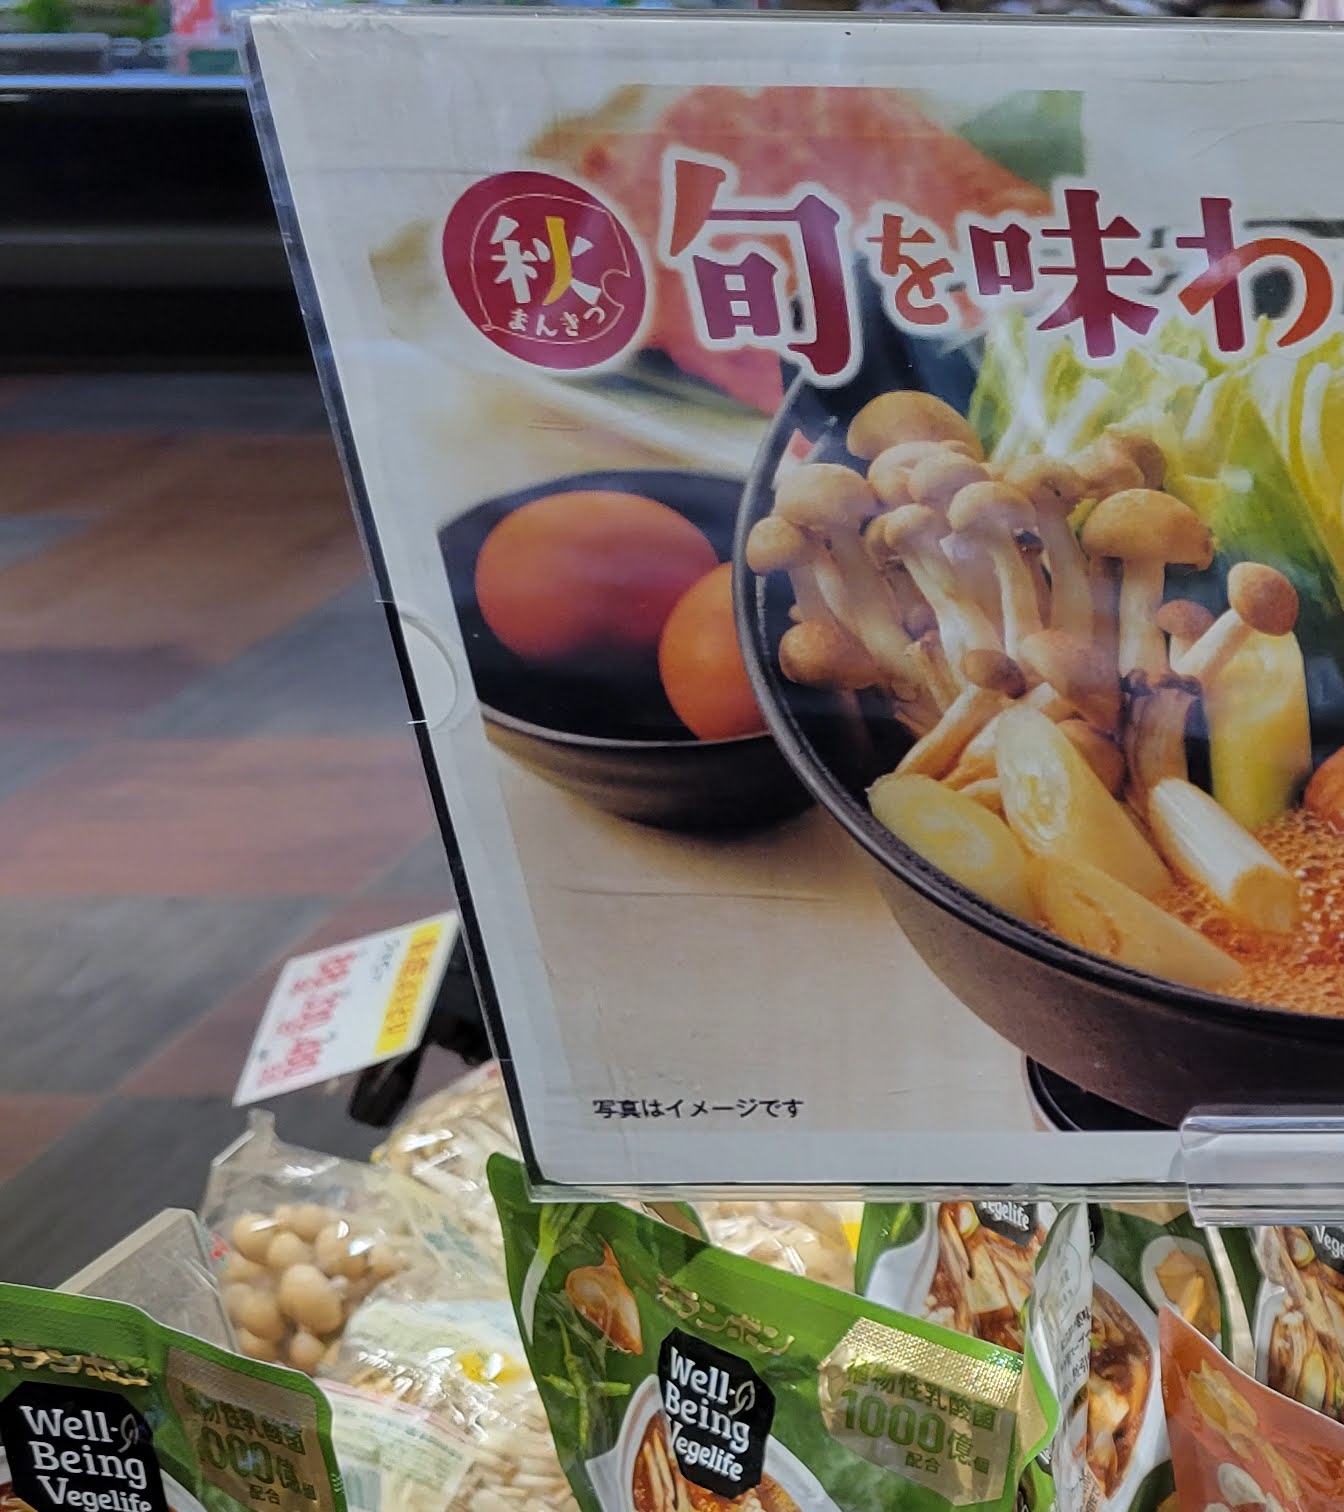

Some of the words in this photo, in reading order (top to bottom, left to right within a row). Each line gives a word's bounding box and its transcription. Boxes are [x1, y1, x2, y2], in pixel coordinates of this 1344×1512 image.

[492, 216, 602, 306] 秋
[508, 307, 605, 338] まんきつ
[592, 1097, 804, 1120] 写真はイメージです
[20, 1405, 118, 1444] Well-
[665, 1383, 751, 1455] Being
[33, 1441, 148, 1488] Being
[668, 1424, 743, 1483] Vegelife
[904, 1451, 941, 1475] 配合
